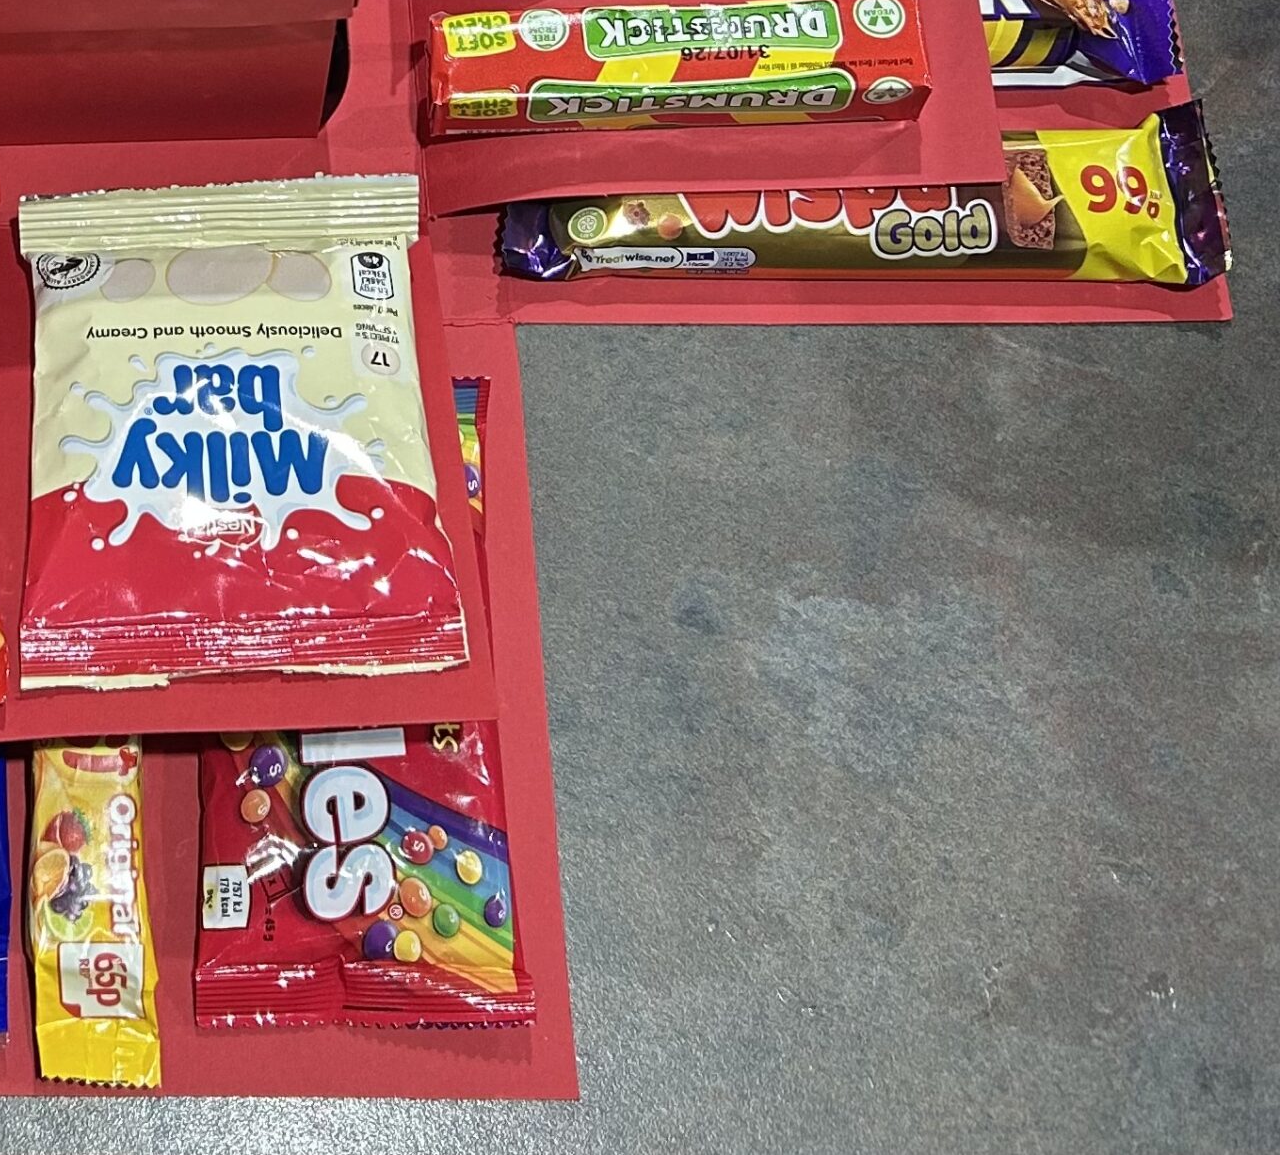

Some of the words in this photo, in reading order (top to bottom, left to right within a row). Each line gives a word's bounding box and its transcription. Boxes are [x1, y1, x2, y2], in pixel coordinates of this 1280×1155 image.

[597, 9, 829, 49] DRUMSTICK
[455, 31, 508, 53] SOFT
[681, 44, 771, 62] 31/07/26
[546, 87, 838, 117] DRUMSTICK
[876, 204, 991, 255] Gold
[86, 327, 149, 342] Creamy
[152, 326, 185, 340] and
[190, 324, 253, 339] Smooth
[256, 322, 343, 340] Deliciously
[370, 350, 391, 369] 17
[153, 362, 283, 433] bar
[112, 417, 329, 505] Milky
[220, 877, 230, 894] 179
[232, 880, 243, 898] 757
[220, 896, 231, 918] kcal
[232, 900, 243, 914] kJ
[93, 951, 127, 1007] 65p
